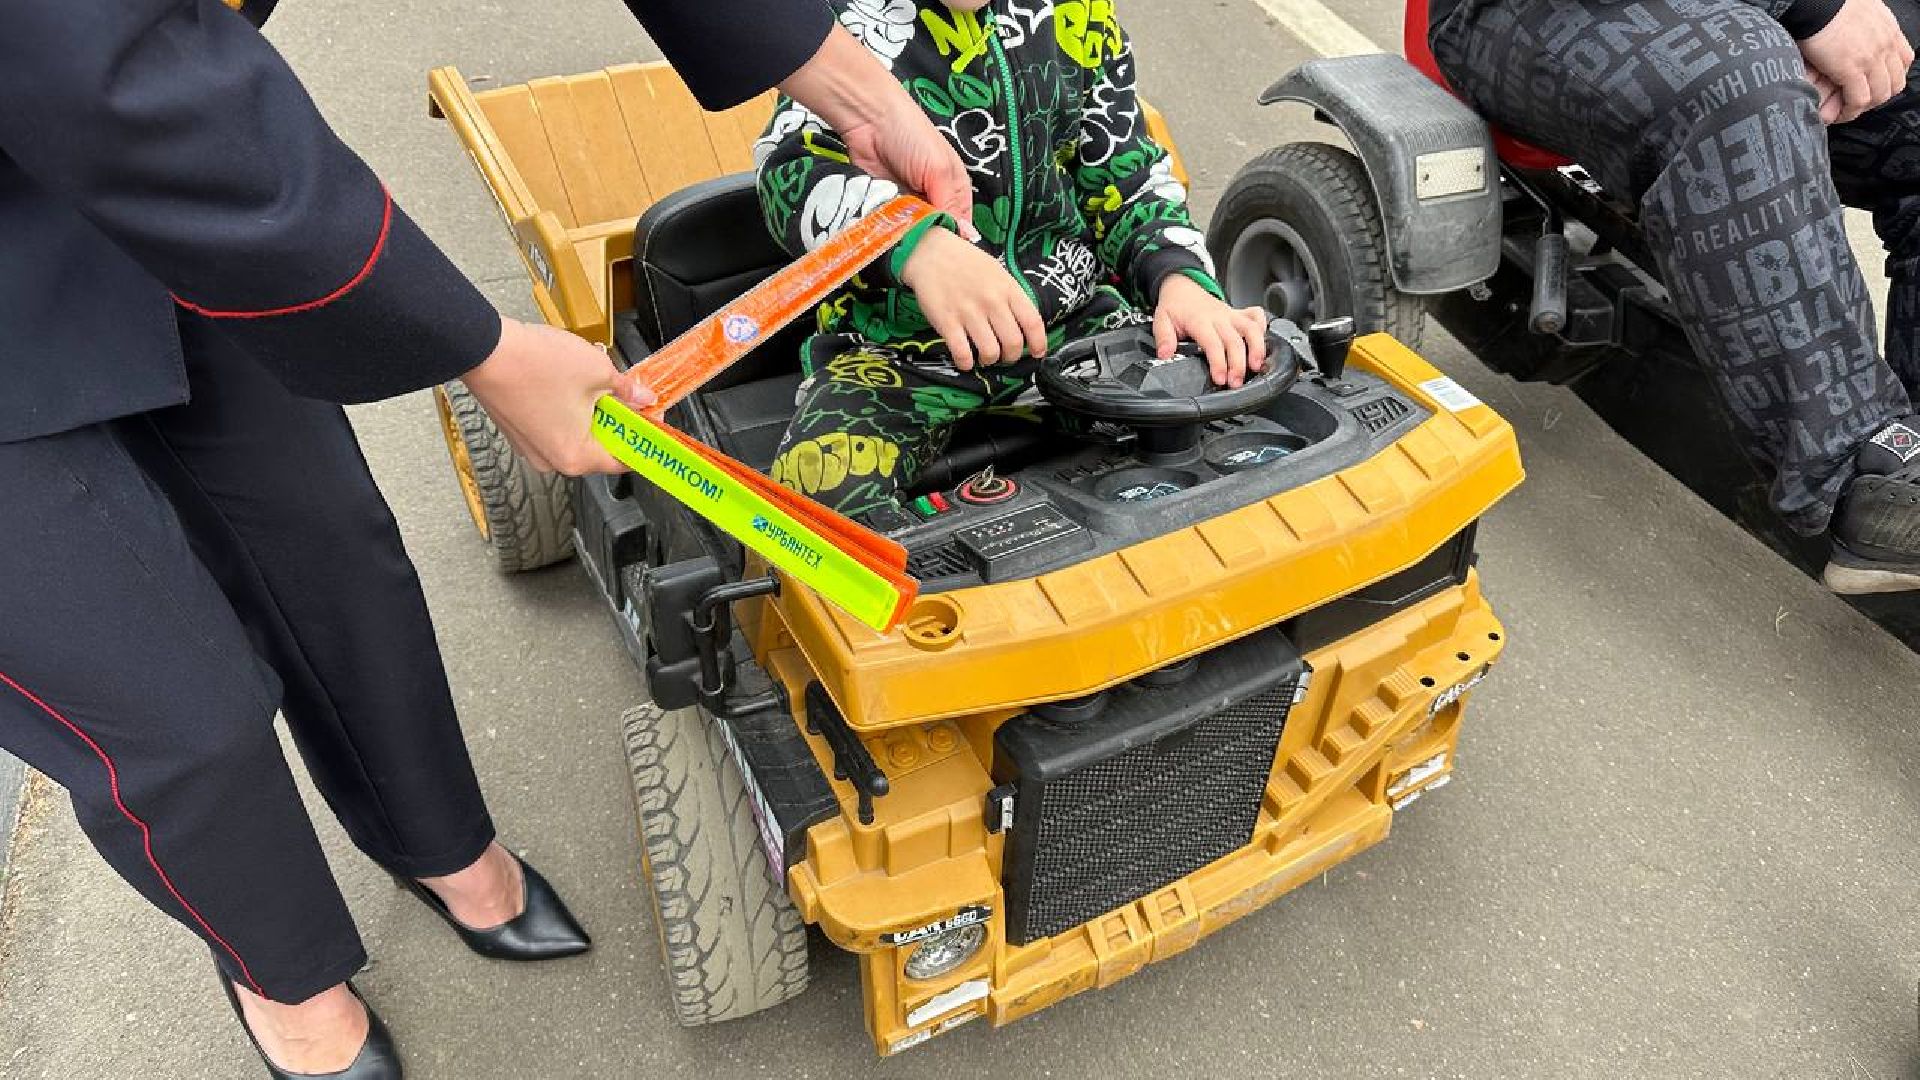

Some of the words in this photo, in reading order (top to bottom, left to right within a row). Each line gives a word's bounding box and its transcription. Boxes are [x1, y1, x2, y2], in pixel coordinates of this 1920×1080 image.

[1684, 69, 1748, 122] HAVE
[1751, 58, 1788, 88] YOU
[1692, 189, 1798, 255] REALITY
[593, 405, 724, 503] ПРАЗДНИКОМ!
